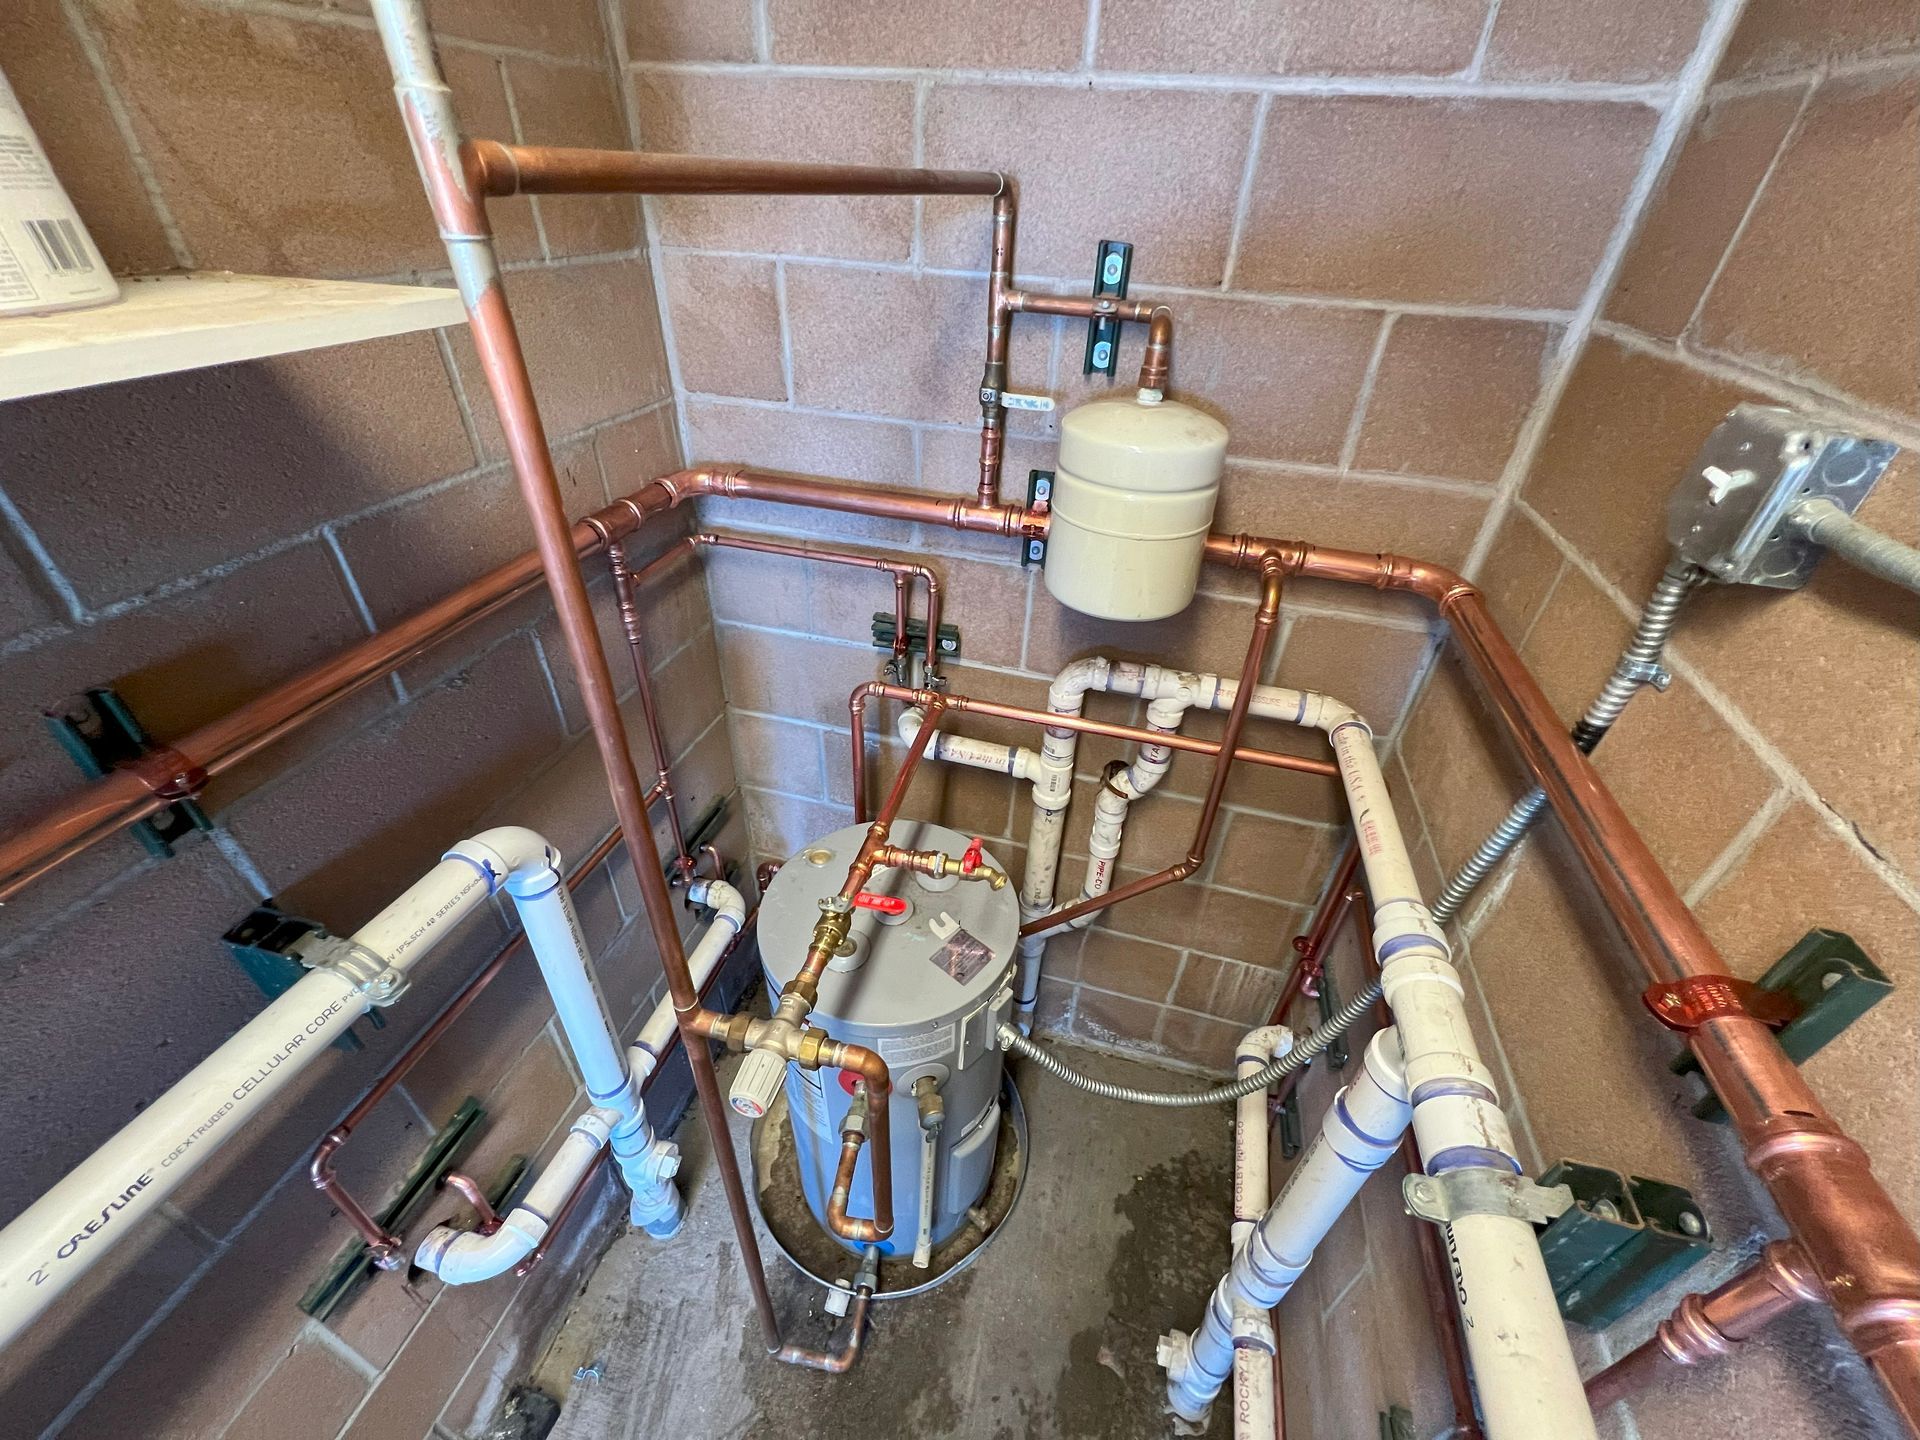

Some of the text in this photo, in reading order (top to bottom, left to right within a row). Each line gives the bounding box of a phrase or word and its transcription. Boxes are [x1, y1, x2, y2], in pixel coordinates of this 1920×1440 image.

[160, 1101, 234, 1168] COEXTRUDED
[232, 1034, 306, 1101] CELLULAR
[305, 1000, 342, 1035] CORE
[435, 894, 461, 918] SERIES
